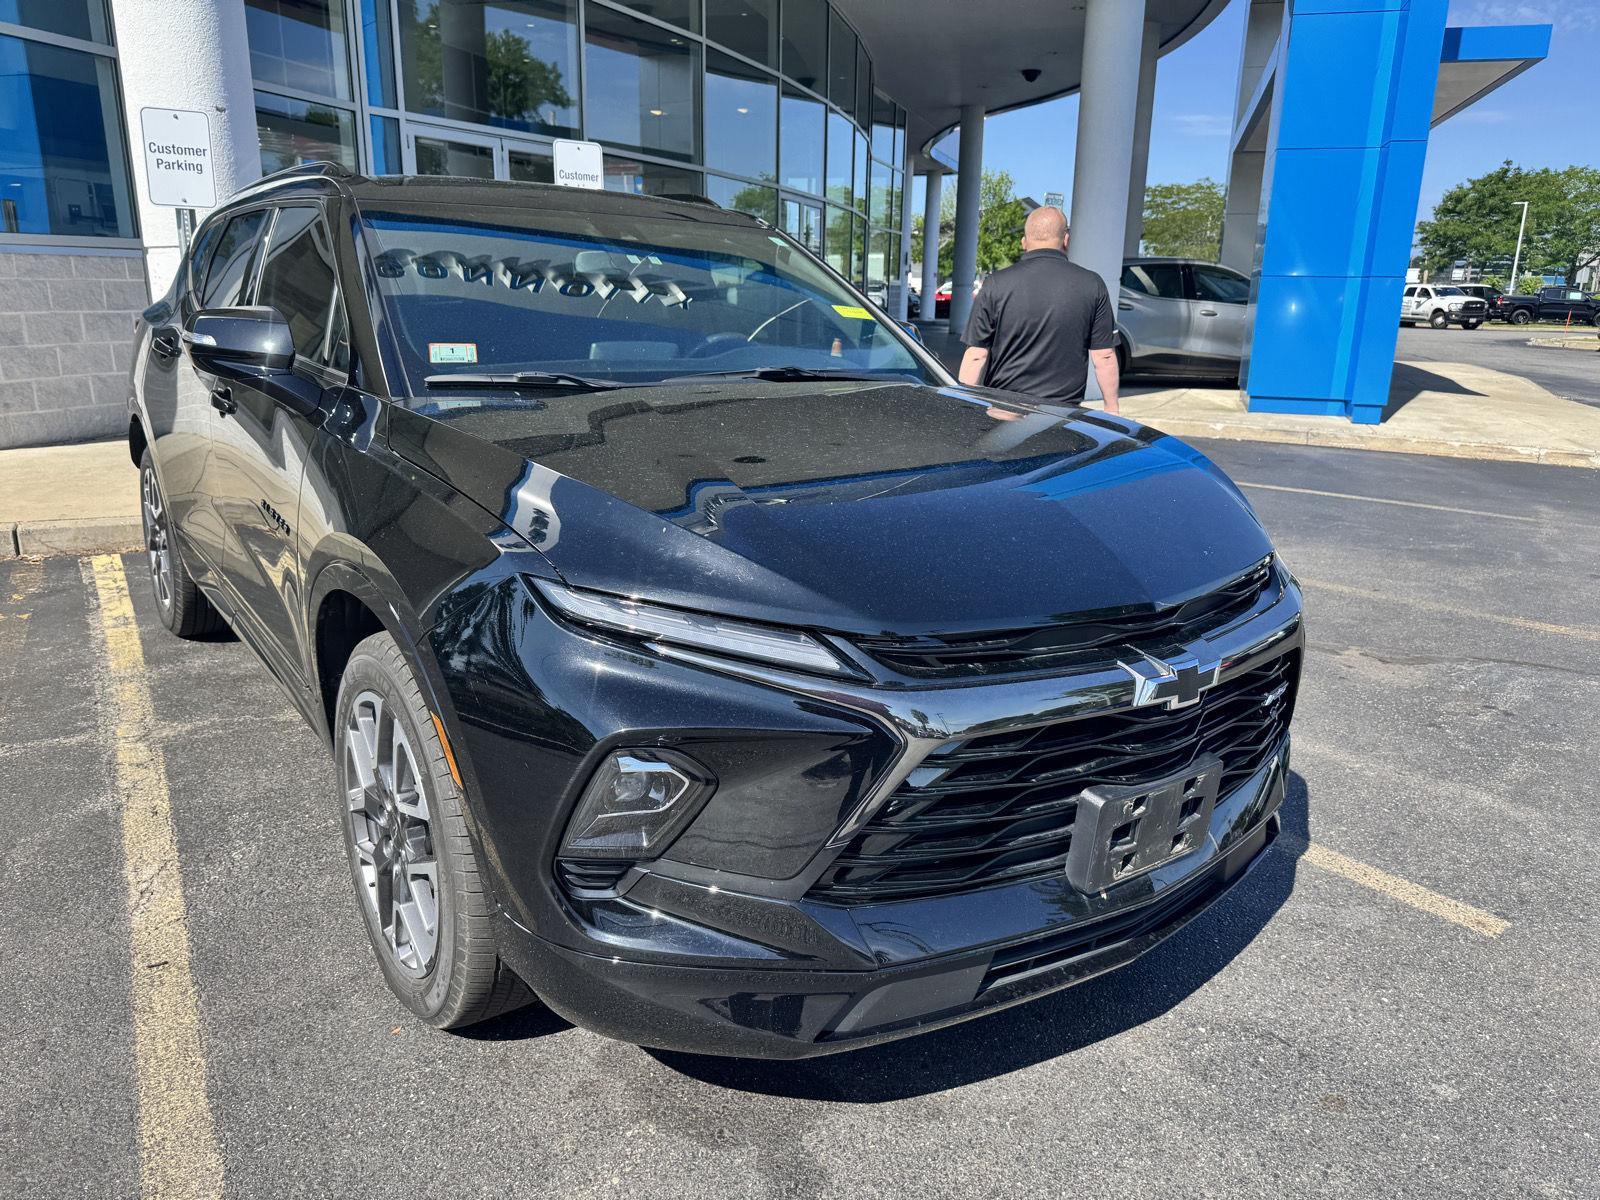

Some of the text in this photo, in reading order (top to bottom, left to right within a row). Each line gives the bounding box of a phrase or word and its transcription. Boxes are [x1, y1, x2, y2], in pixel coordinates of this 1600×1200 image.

[148, 141, 208, 157] Customer
[156, 158, 203, 175] Parking
[558, 169, 600, 182] Customer
